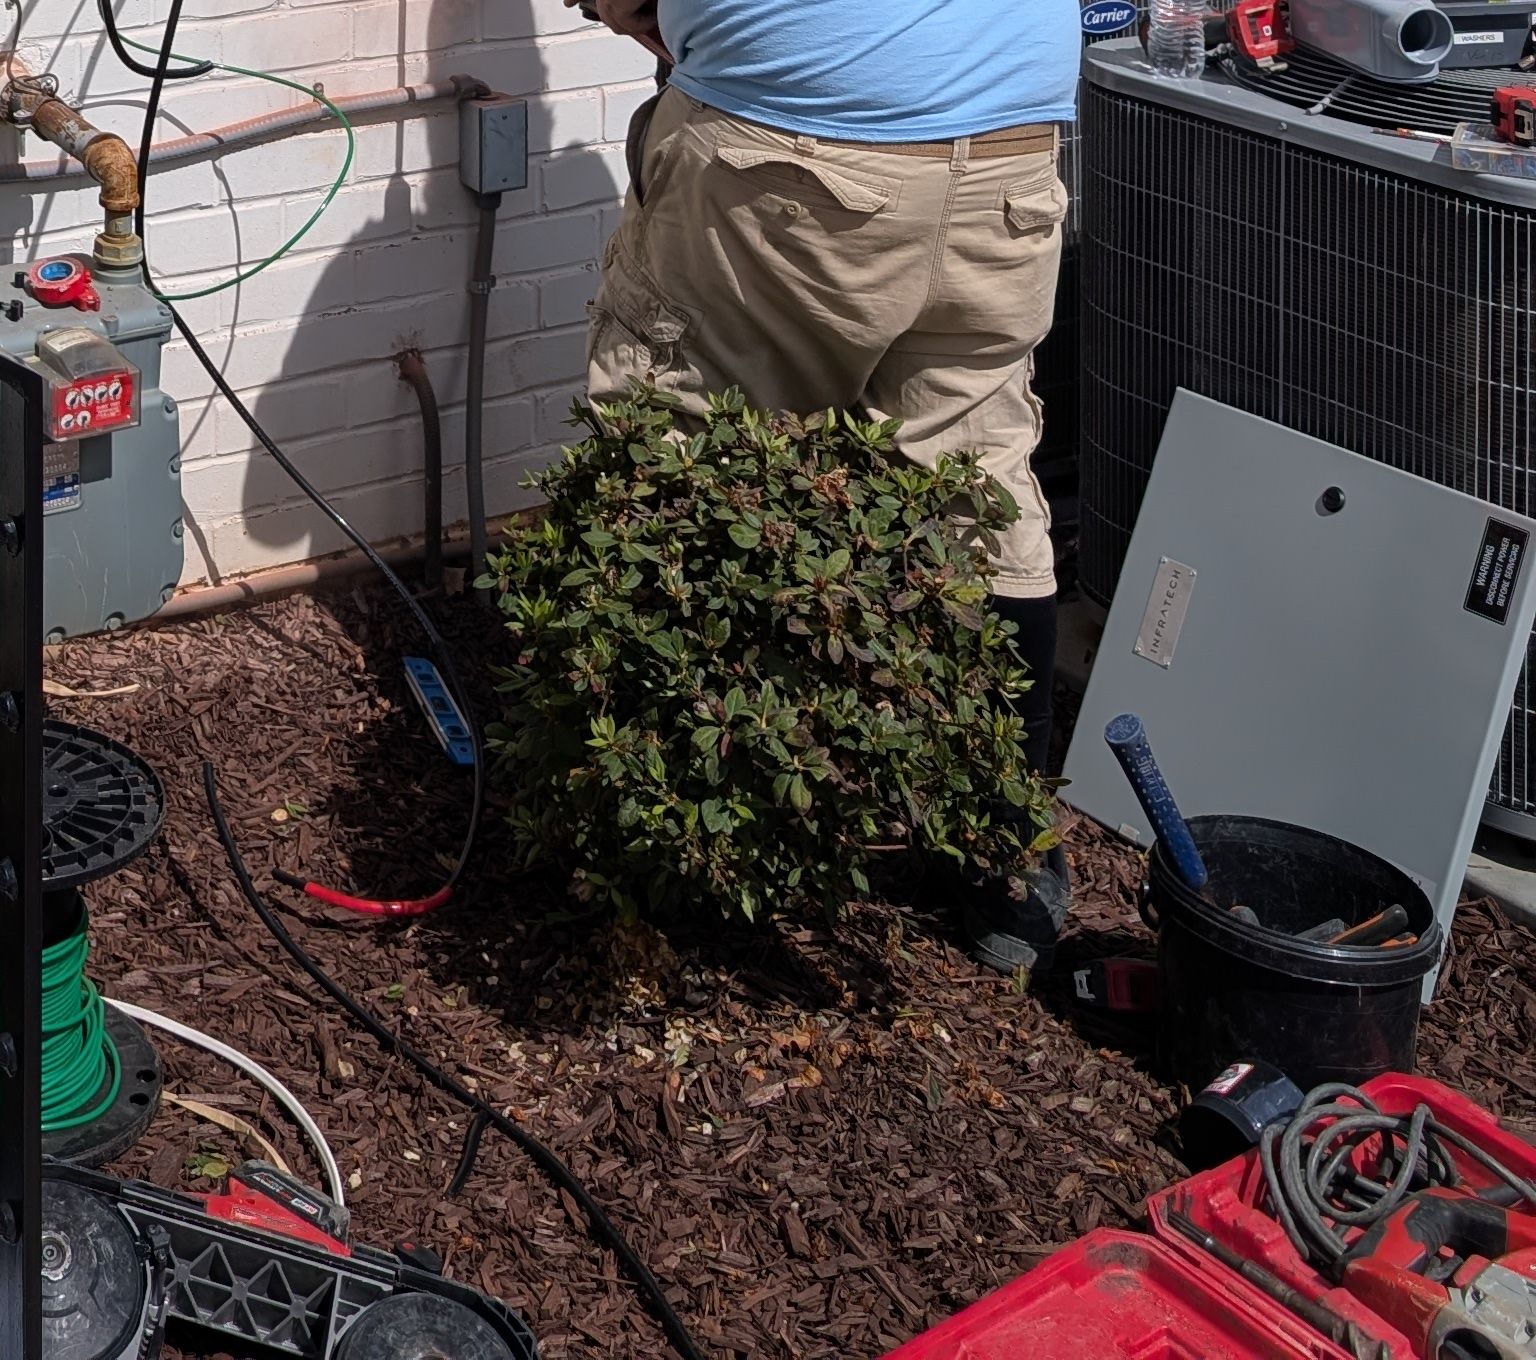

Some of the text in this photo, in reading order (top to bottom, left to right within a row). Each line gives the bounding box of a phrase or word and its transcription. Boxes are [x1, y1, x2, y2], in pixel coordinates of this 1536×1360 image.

[1084, 7, 1131, 26] Carrier
[1461, 34, 1496, 42] WASHERS
[1476, 544, 1495, 586] WARNING
[1485, 537, 1511, 606] DISCONNECT POWER
[1496, 579, 1511, 607] BEFORE
[1150, 569, 1182, 654] INFRATECH
